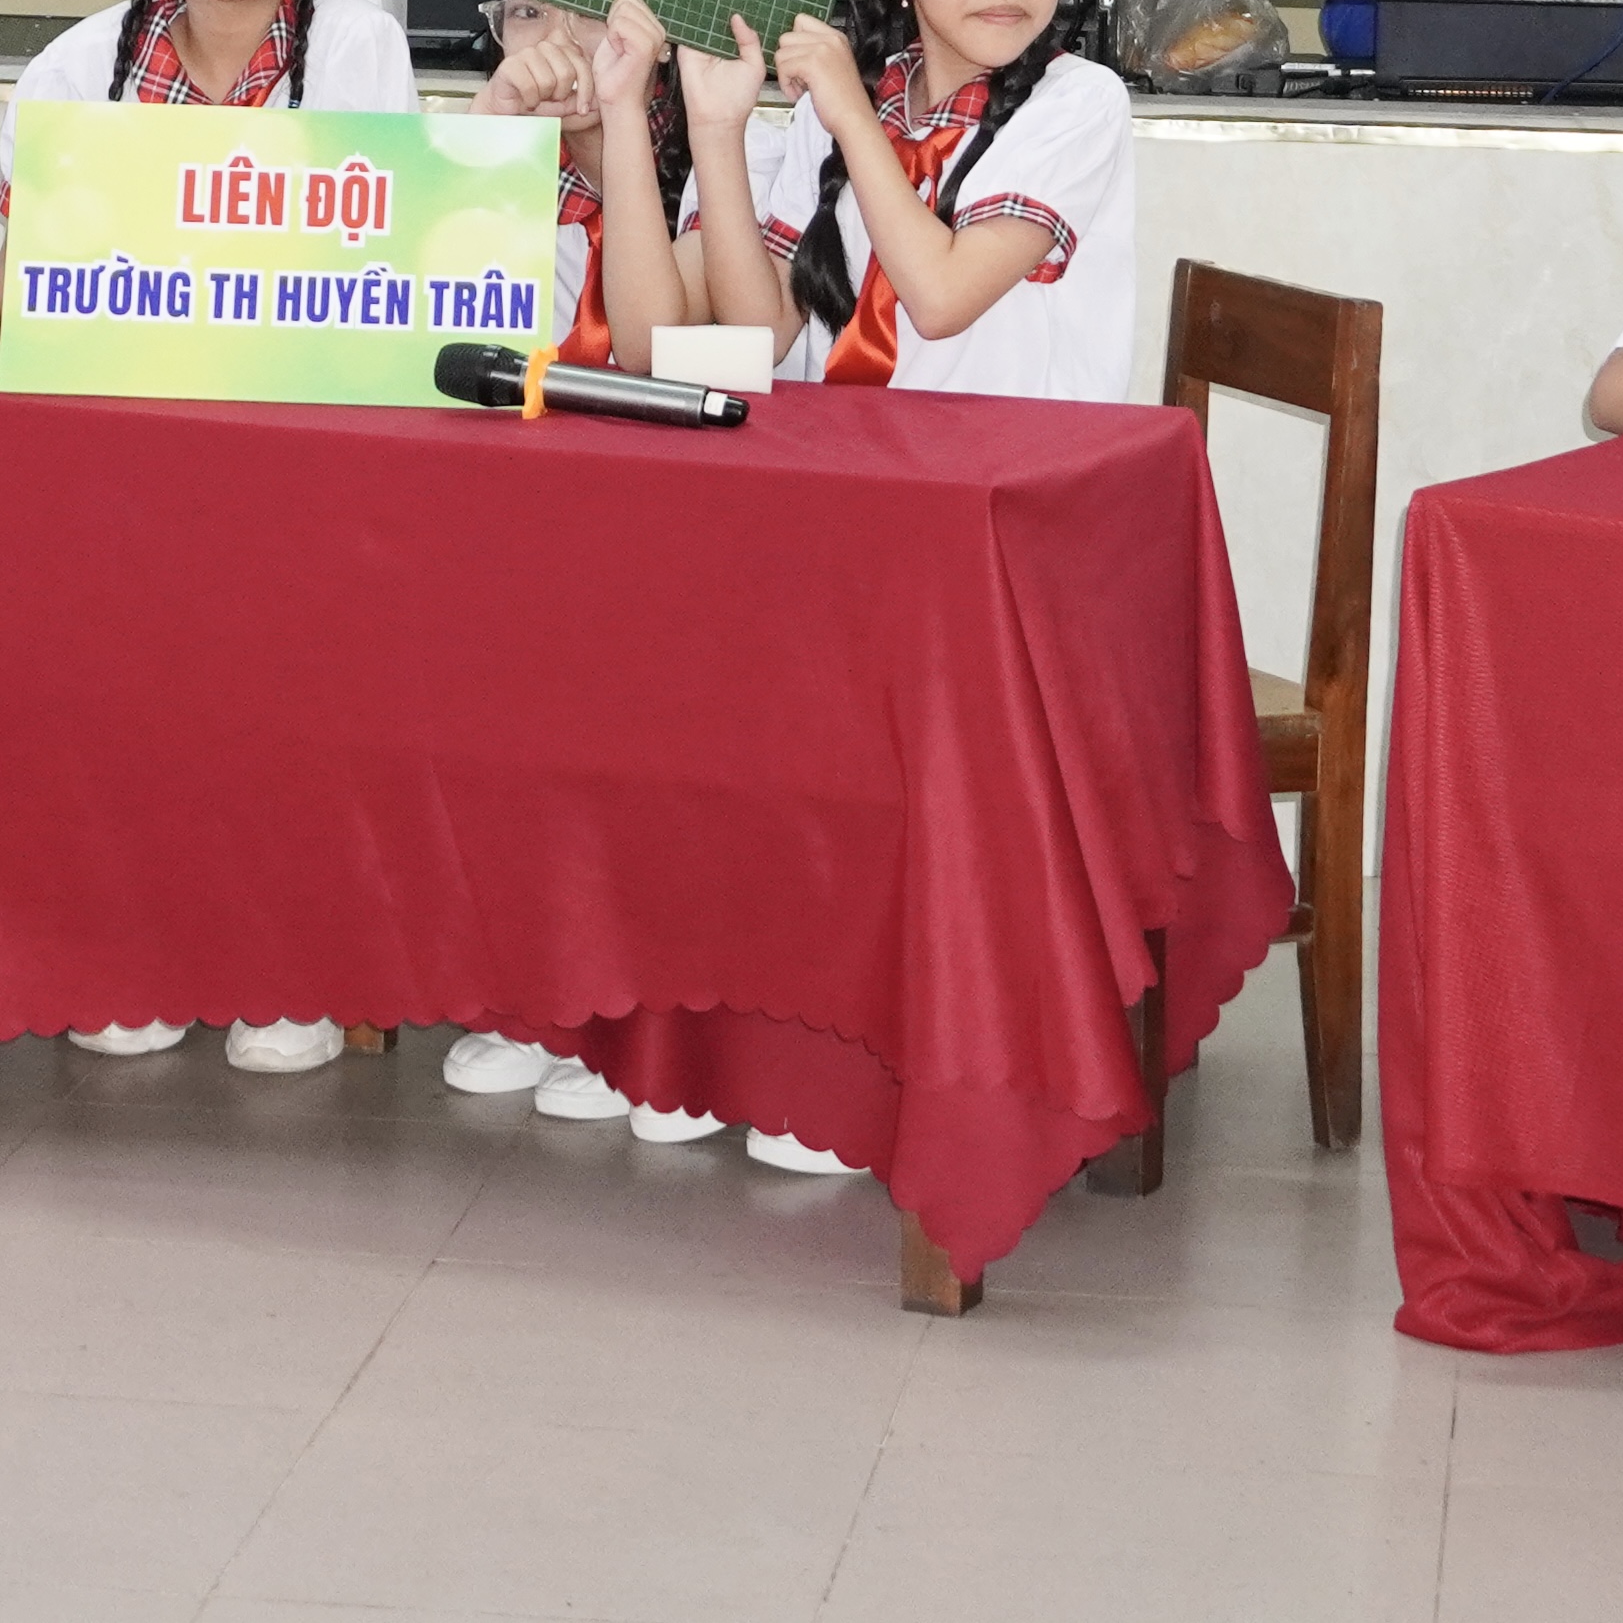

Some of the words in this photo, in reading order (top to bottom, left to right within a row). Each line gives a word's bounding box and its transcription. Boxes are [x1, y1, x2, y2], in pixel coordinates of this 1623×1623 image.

[181, 156, 286, 227] LIÊN
[305, 162, 388, 242] ĐỘI
[23, 255, 192, 318] TRƯỜNG
[210, 273, 259, 320] TH
[276, 267, 411, 326] HUYỀN
[430, 269, 535, 330] TRÂN
